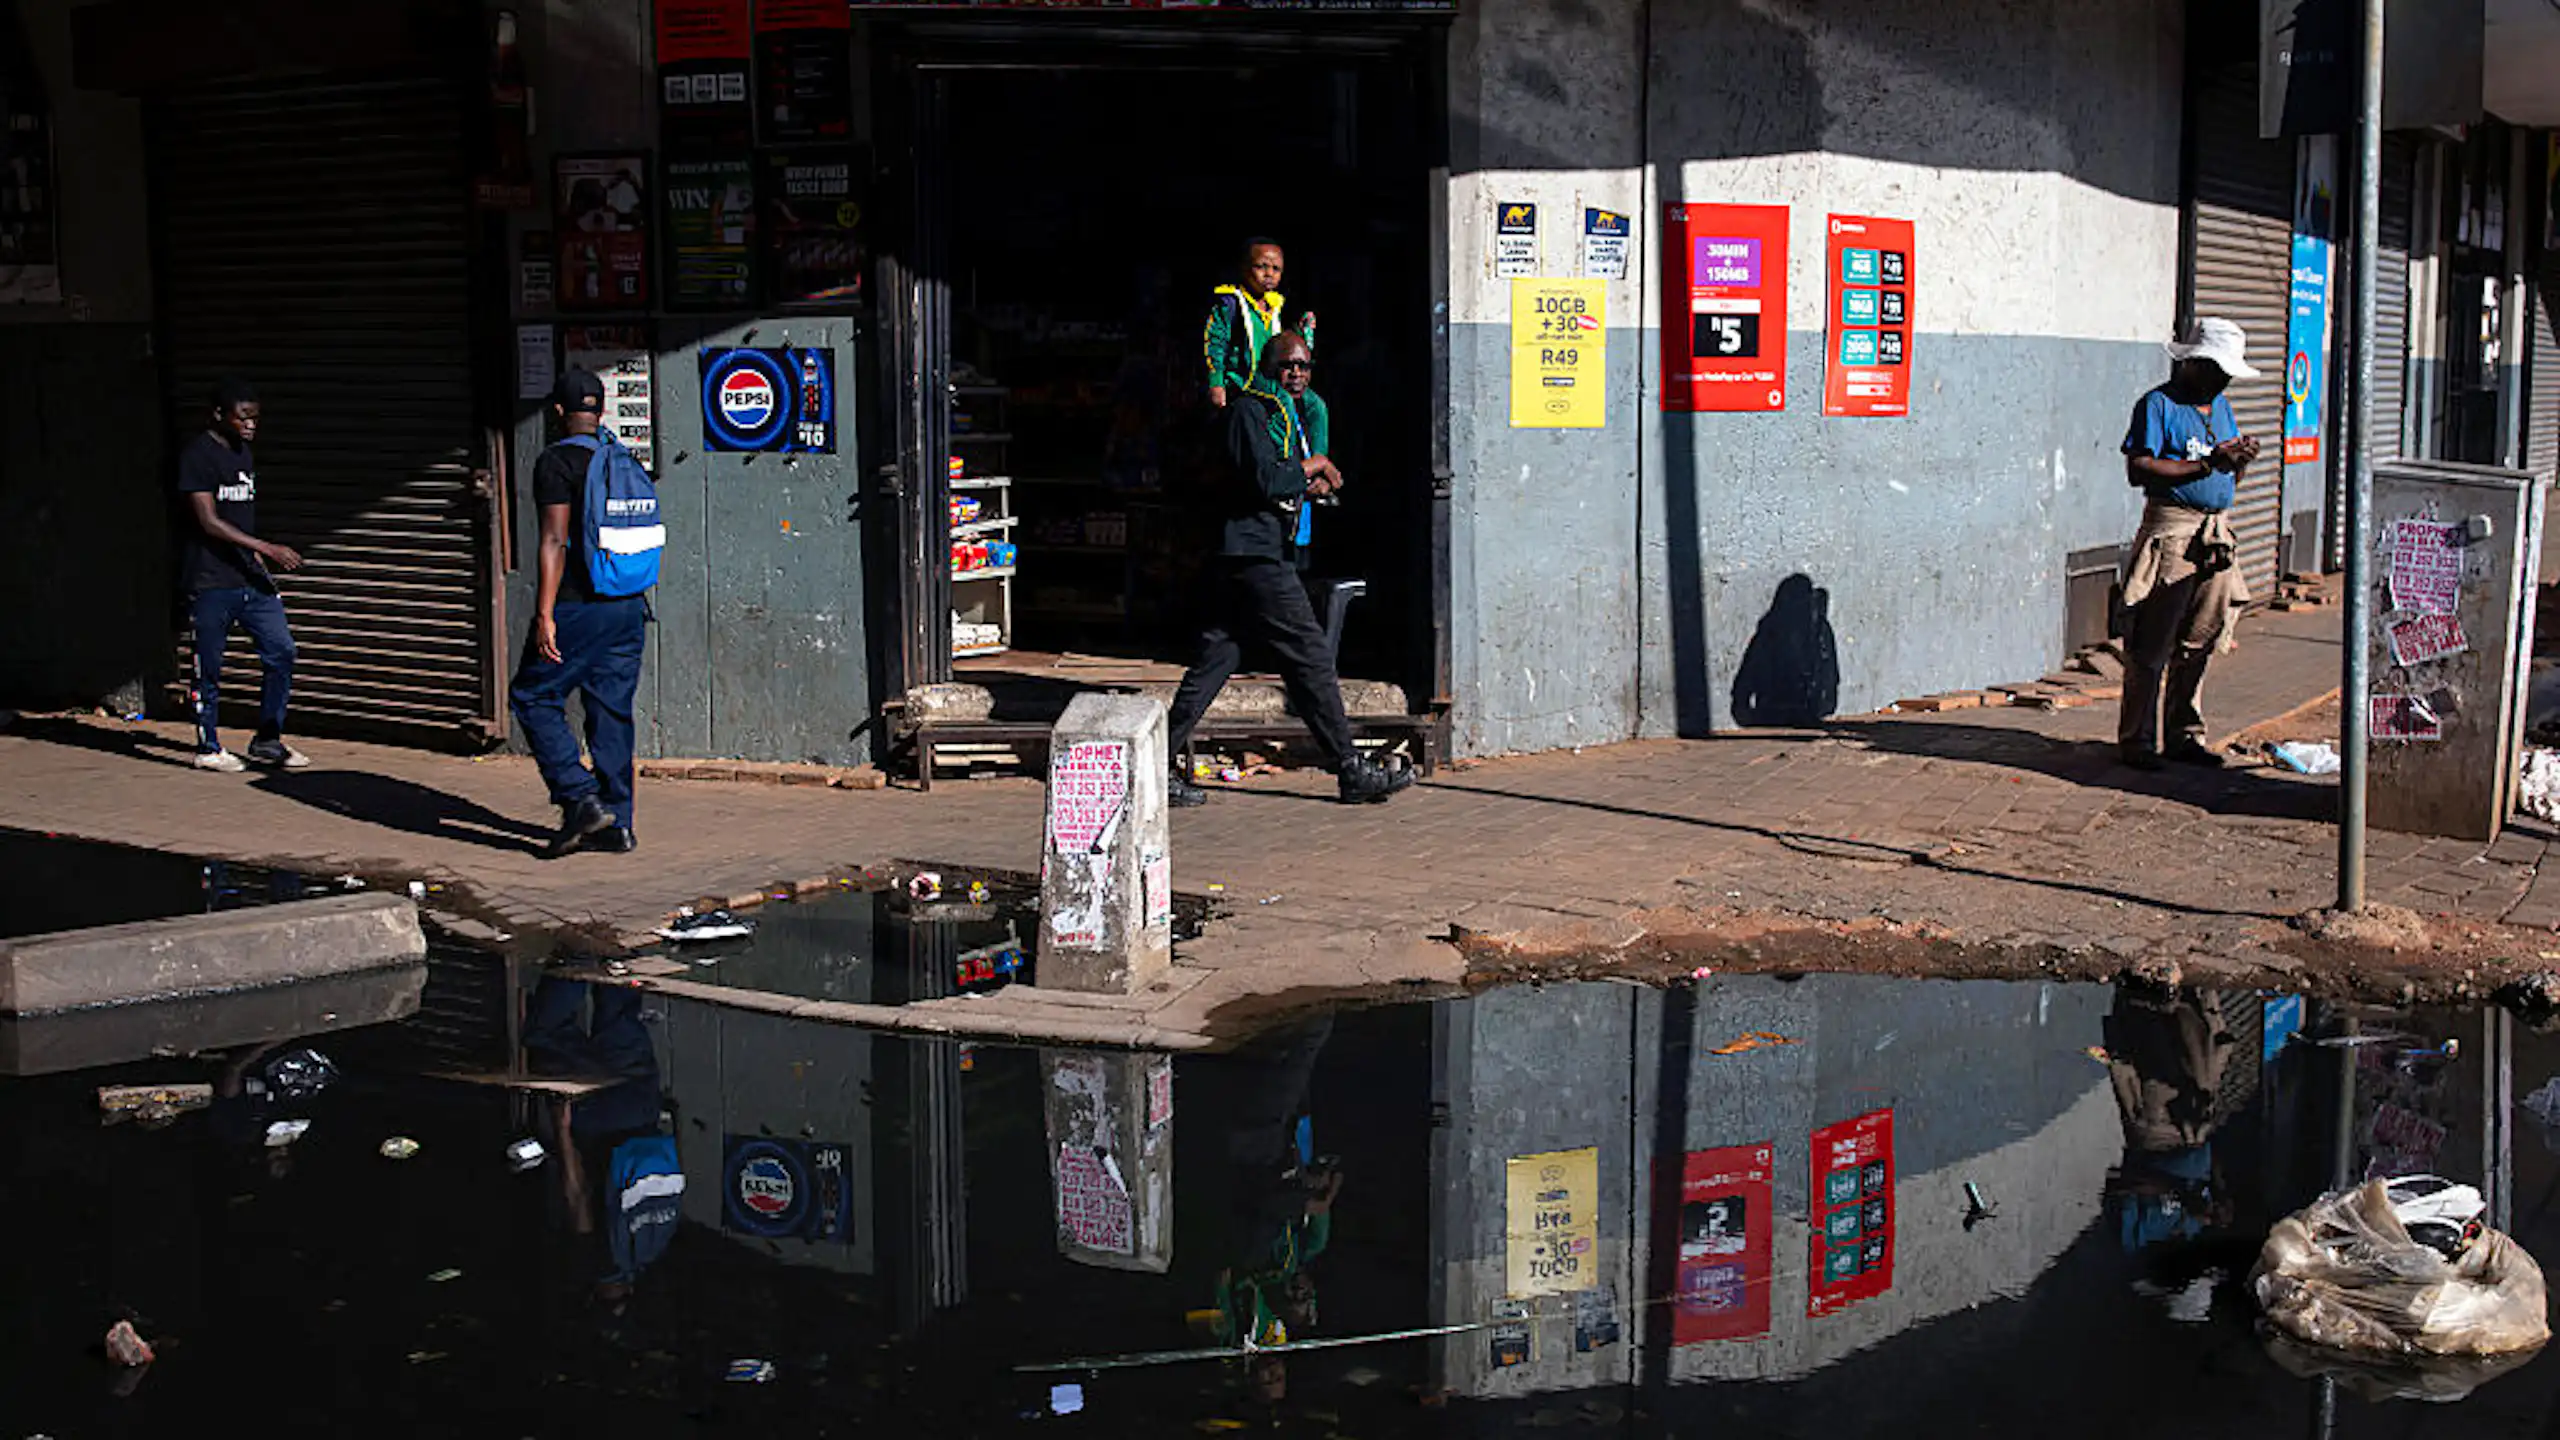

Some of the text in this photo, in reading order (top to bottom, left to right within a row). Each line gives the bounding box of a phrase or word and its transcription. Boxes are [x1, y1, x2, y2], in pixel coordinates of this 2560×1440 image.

[1534, 297, 1586, 314] 10GB
[1541, 348, 1579, 366] R49
[725, 393, 770, 405] PEPSI
[1069, 745, 1122, 760] OPHET
